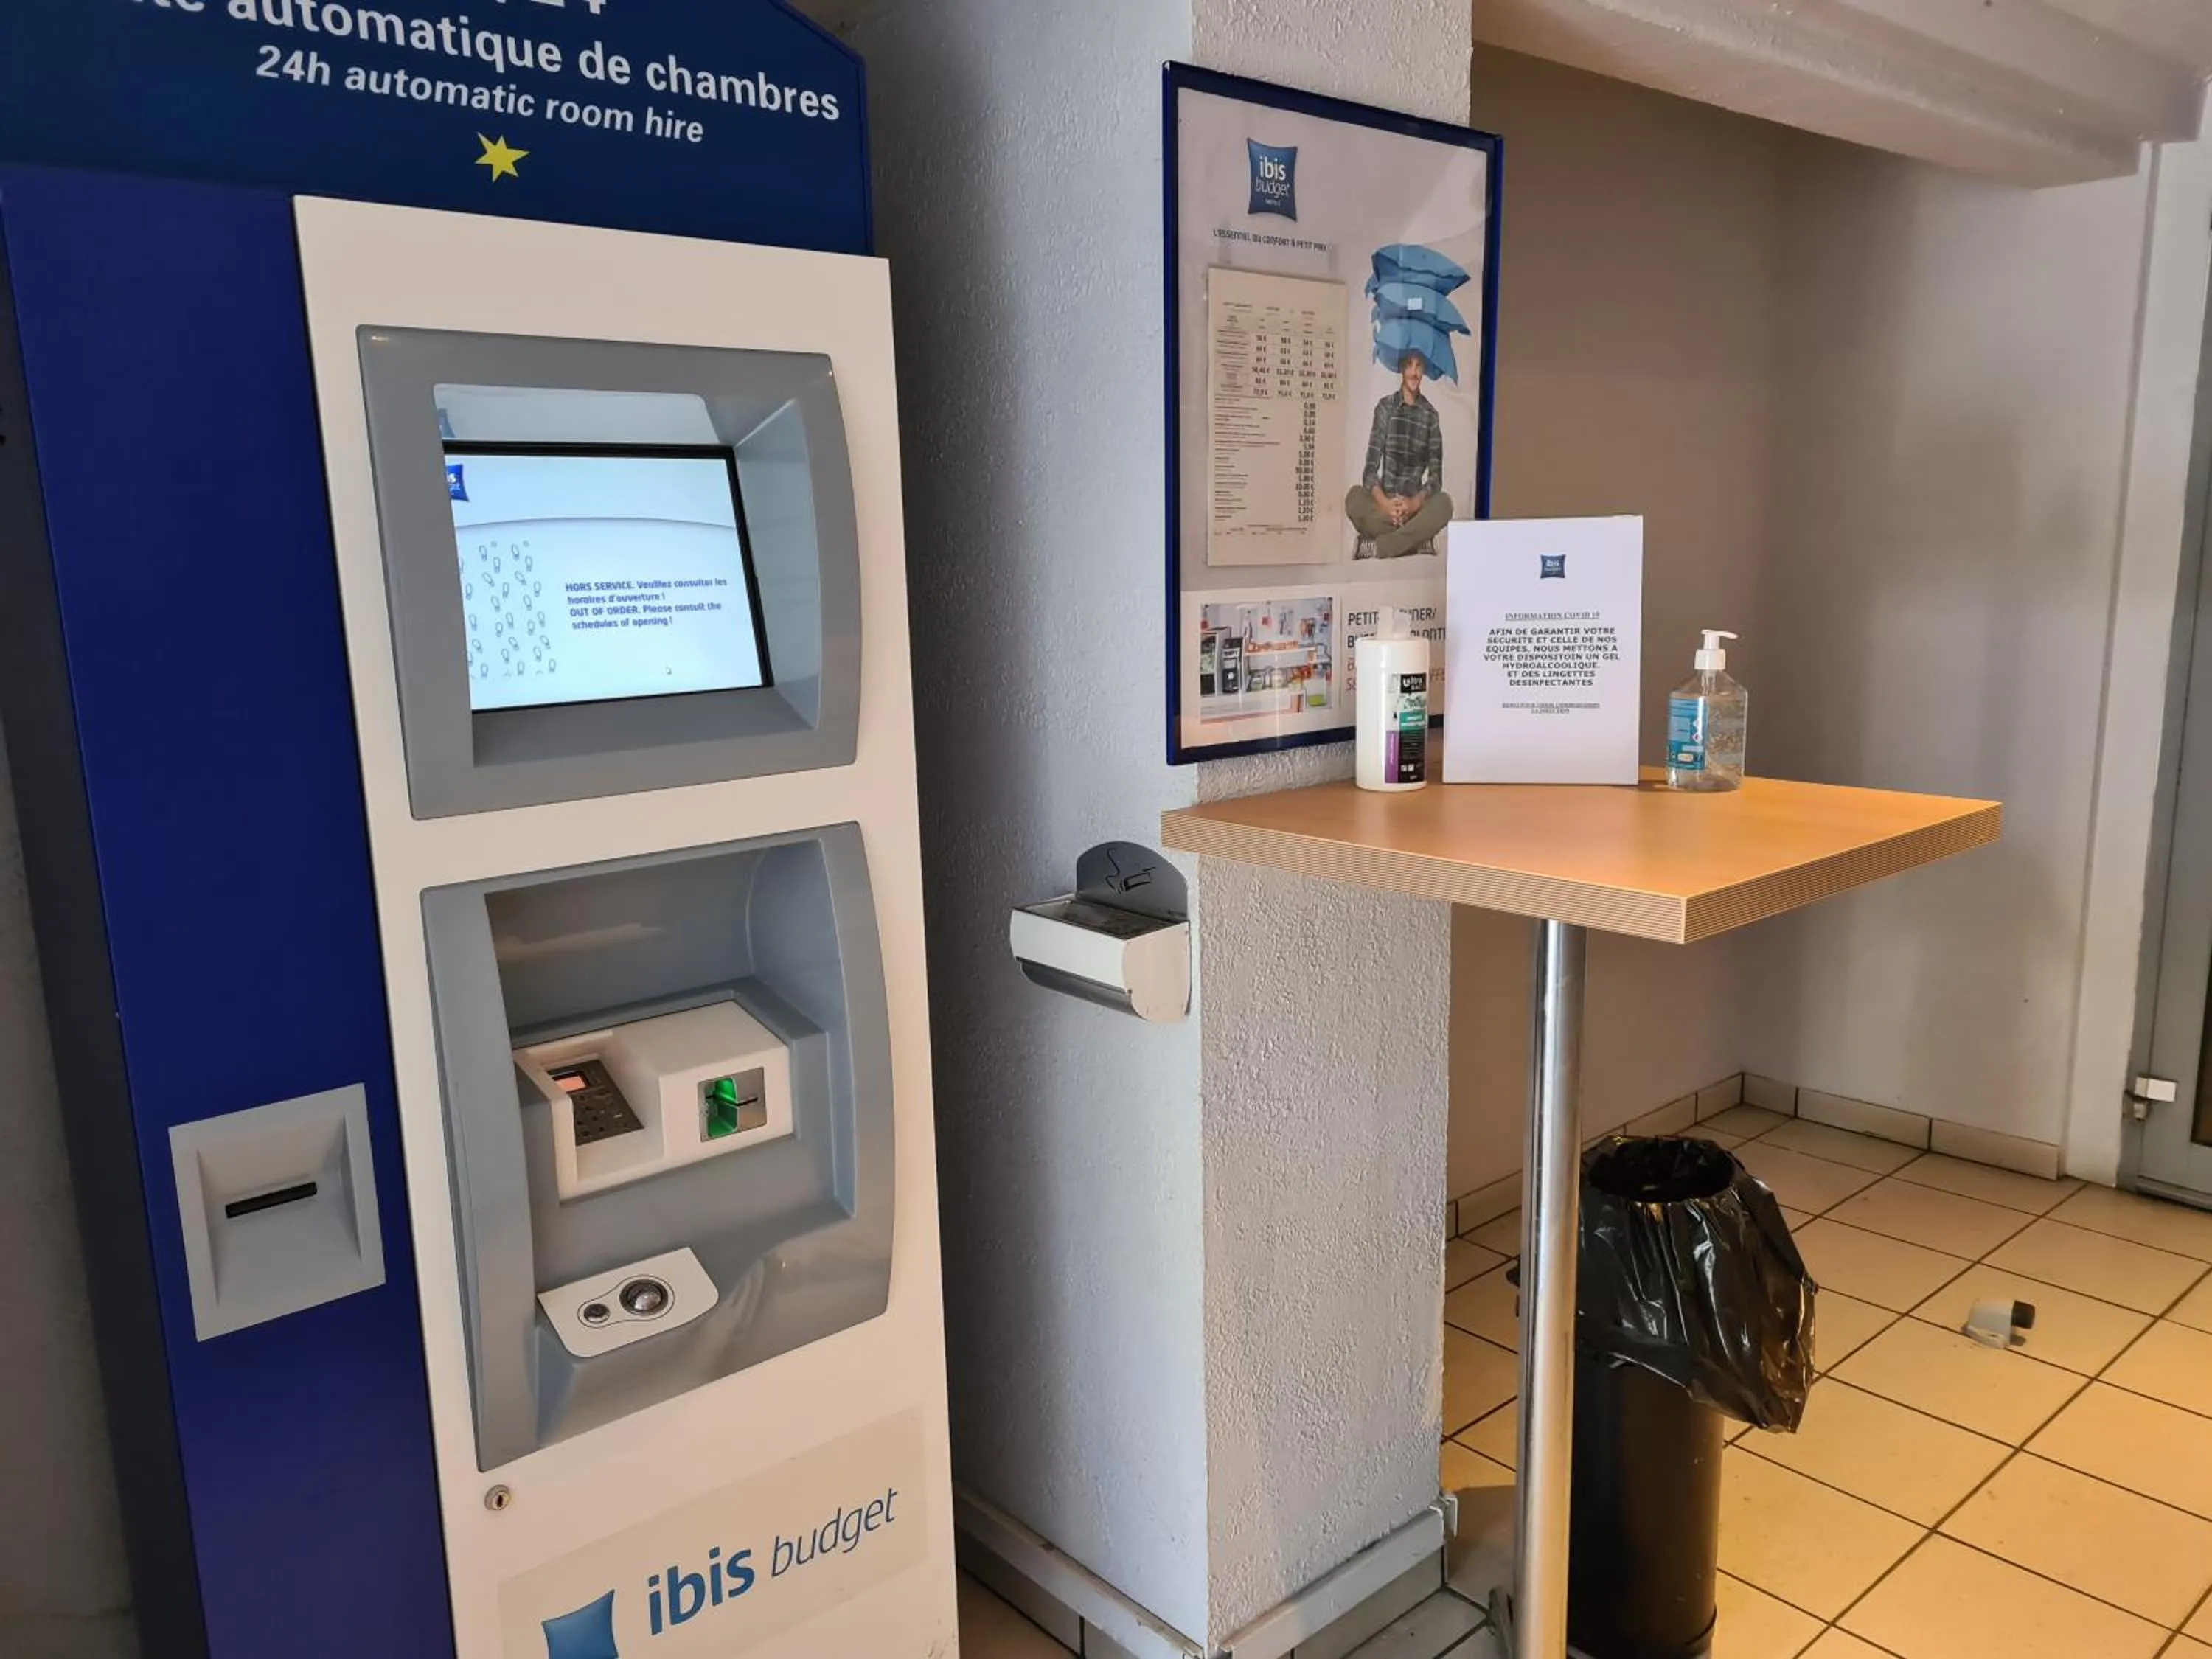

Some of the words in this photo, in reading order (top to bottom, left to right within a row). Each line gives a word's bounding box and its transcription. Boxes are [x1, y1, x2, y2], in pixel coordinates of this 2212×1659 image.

[228, 0, 563, 72] automatique
[579, 42, 631, 85] de
[646, 55, 841, 120] chambres
[256, 46, 331, 86] 24h
[344, 66, 535, 116] automatic
[546, 99, 633, 131] room
[645, 107, 704, 142] hire
[1259, 156, 1286, 181] ibis
[1255, 177, 1290, 198] budget
[566, 582, 592, 591] HORS
[715, 577, 727, 587] les
[567, 594, 605, 605] horaires
[570, 608, 588, 616] OUT
[592, 606, 604, 616] OF
[643, 604, 672, 613] Please
[675, 602, 705, 612] consult
[707, 601, 721, 610] the
[572, 619, 618, 629] schedules
[620, 618, 629, 626] of
[632, 616, 668, 627] opening
[1505, 612, 1562, 621] INFORMATION
[1563, 611, 1590, 620] COVID
[1489, 627, 1512, 636] AFIN
[1515, 627, 1528, 636] DE
[1530, 627, 1581, 636] GARANTIR
[1583, 627, 1615, 635] VOTRE
[1486, 645, 1530, 654] EQUIPES,
[1562, 644, 1608, 653] METTONS
[1484, 653, 1514, 661] VOTRE
[1517, 653, 1582, 661] DISPOSITOIN
[1601, 653, 1620, 661] GEL
[1502, 662, 1600, 670] HYDROALCOOLIQUE.
[647, 1546, 755, 1635] ibis
[771, 1487, 897, 1578] budget
